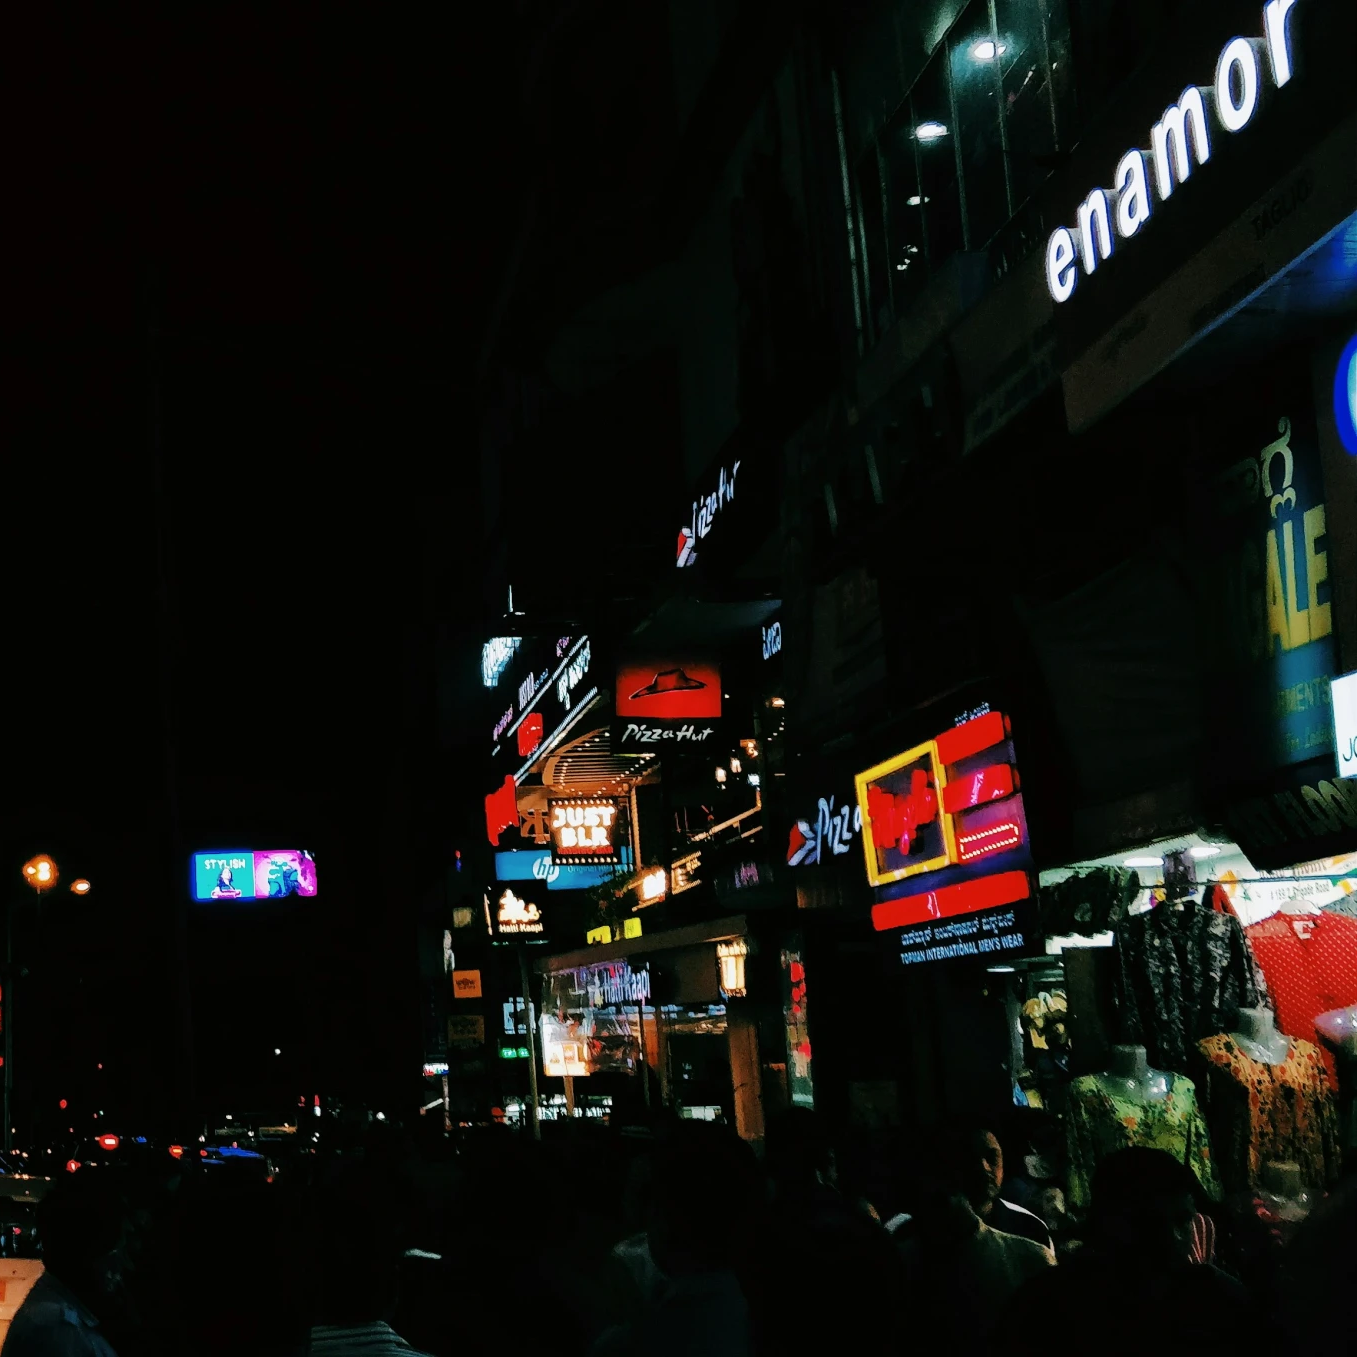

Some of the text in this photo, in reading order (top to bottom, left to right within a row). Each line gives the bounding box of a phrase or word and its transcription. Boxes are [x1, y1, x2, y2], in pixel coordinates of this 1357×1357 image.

[1046, 0, 1295, 303] enamor
[622, 724, 714, 742] Pizza Hut
[552, 806, 615, 828] JUST
[560, 827, 610, 847] BLR
[204, 859, 245, 869] STYLISH
[900, 933, 1024, 965] TOPMAN INTERNATIONAL MEN'S WEAR
